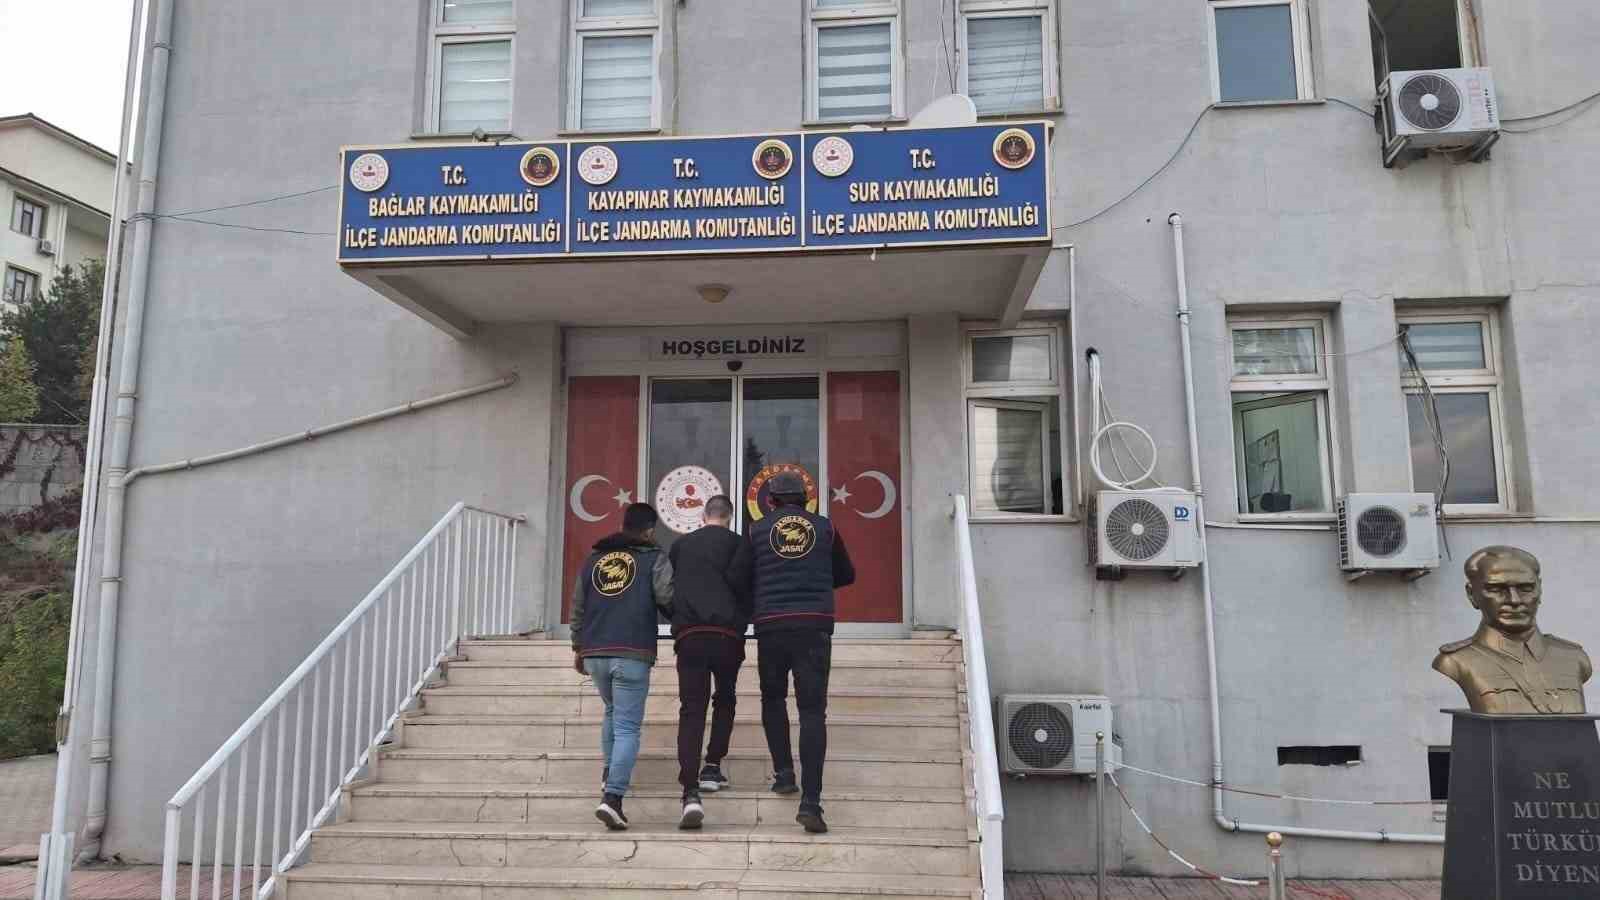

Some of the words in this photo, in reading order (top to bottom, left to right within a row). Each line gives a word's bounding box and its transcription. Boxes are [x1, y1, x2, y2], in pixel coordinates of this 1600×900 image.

[673, 158, 699, 178] T.C.
[909, 148, 936, 169] T.C.
[441, 165, 467, 185] T.C.
[849, 181, 880, 202] SUR
[884, 172, 999, 200] KAYMAKAMLIĞI
[368, 192, 426, 217] BAĞLAR
[429, 188, 539, 215] KAYMAKAMLIĞI
[588, 188, 669, 211] KAYAPINAR
[673, 181, 785, 208] KAYMAKAMLIĞI
[576, 218, 610, 243] İLÇE
[612, 219, 692, 241] JANDARMA
[695, 211, 796, 238] KOMUTANLIĞI
[812, 210, 845, 236] İLÇE
[849, 211, 931, 233] JANDARMA
[934, 201, 1039, 230] KOMUTANLIĞI
[345, 223, 377, 249] İLÇE
[379, 225, 459, 247] JANDARMA
[461, 218, 561, 244] KOMUTANLIĞI
[662, 336, 805, 357] HOŞGELDİNİZ
[1533, 771, 1571, 789] NE
[1512, 801, 1600, 819] MUTLU
[1507, 827, 1600, 852] TÜRKÜ
[1515, 860, 1600, 883] DİYEN
